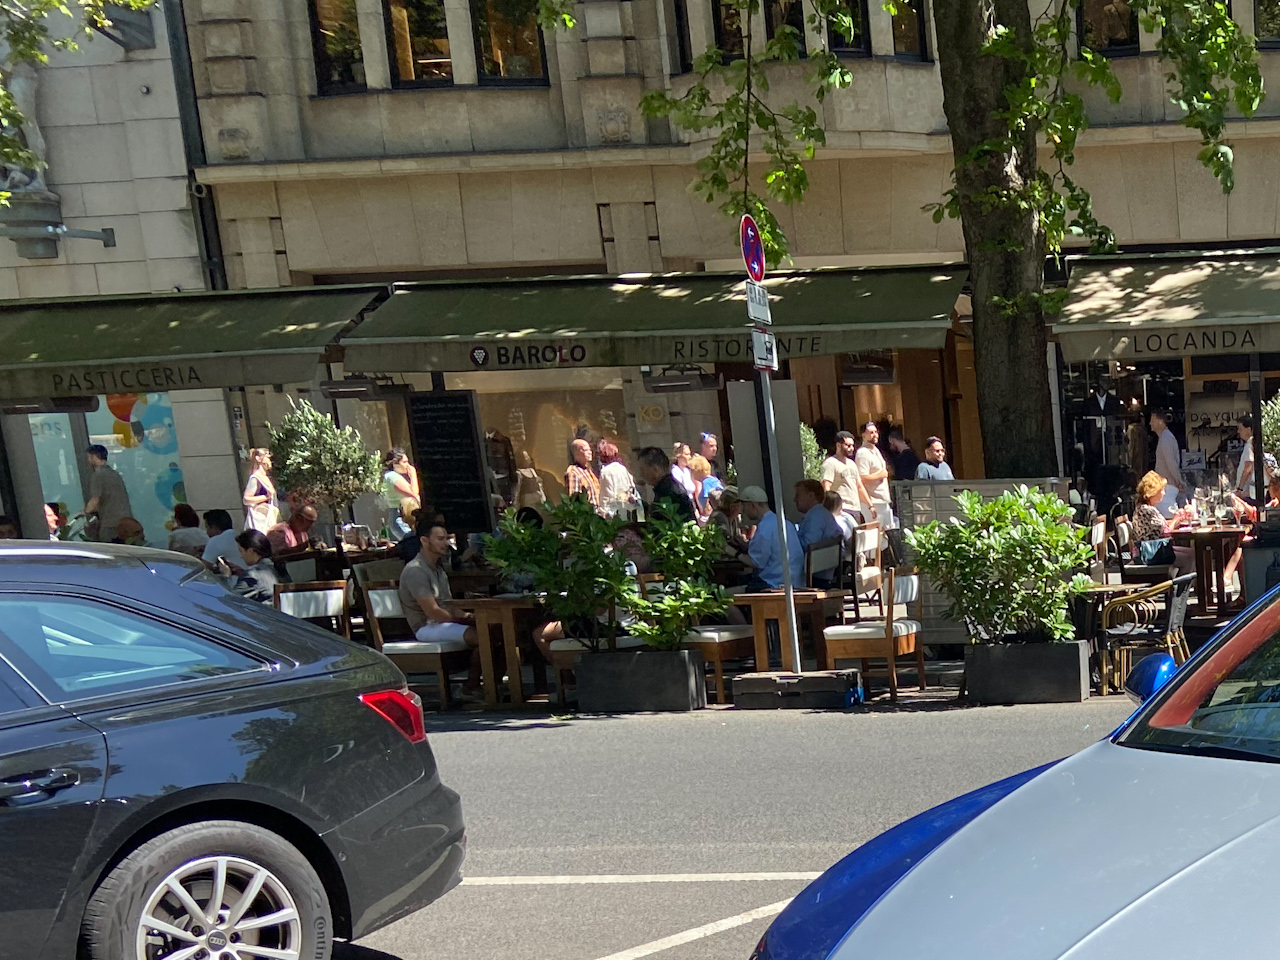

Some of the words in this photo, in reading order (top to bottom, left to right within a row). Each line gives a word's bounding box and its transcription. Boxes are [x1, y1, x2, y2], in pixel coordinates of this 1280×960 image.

[674, 337, 821, 358] RISTORNTE
[1133, 330, 1256, 353] LOCANDA
[497, 345, 587, 365] BAROLO
[53, 366, 202, 392] PASTICCERIA
